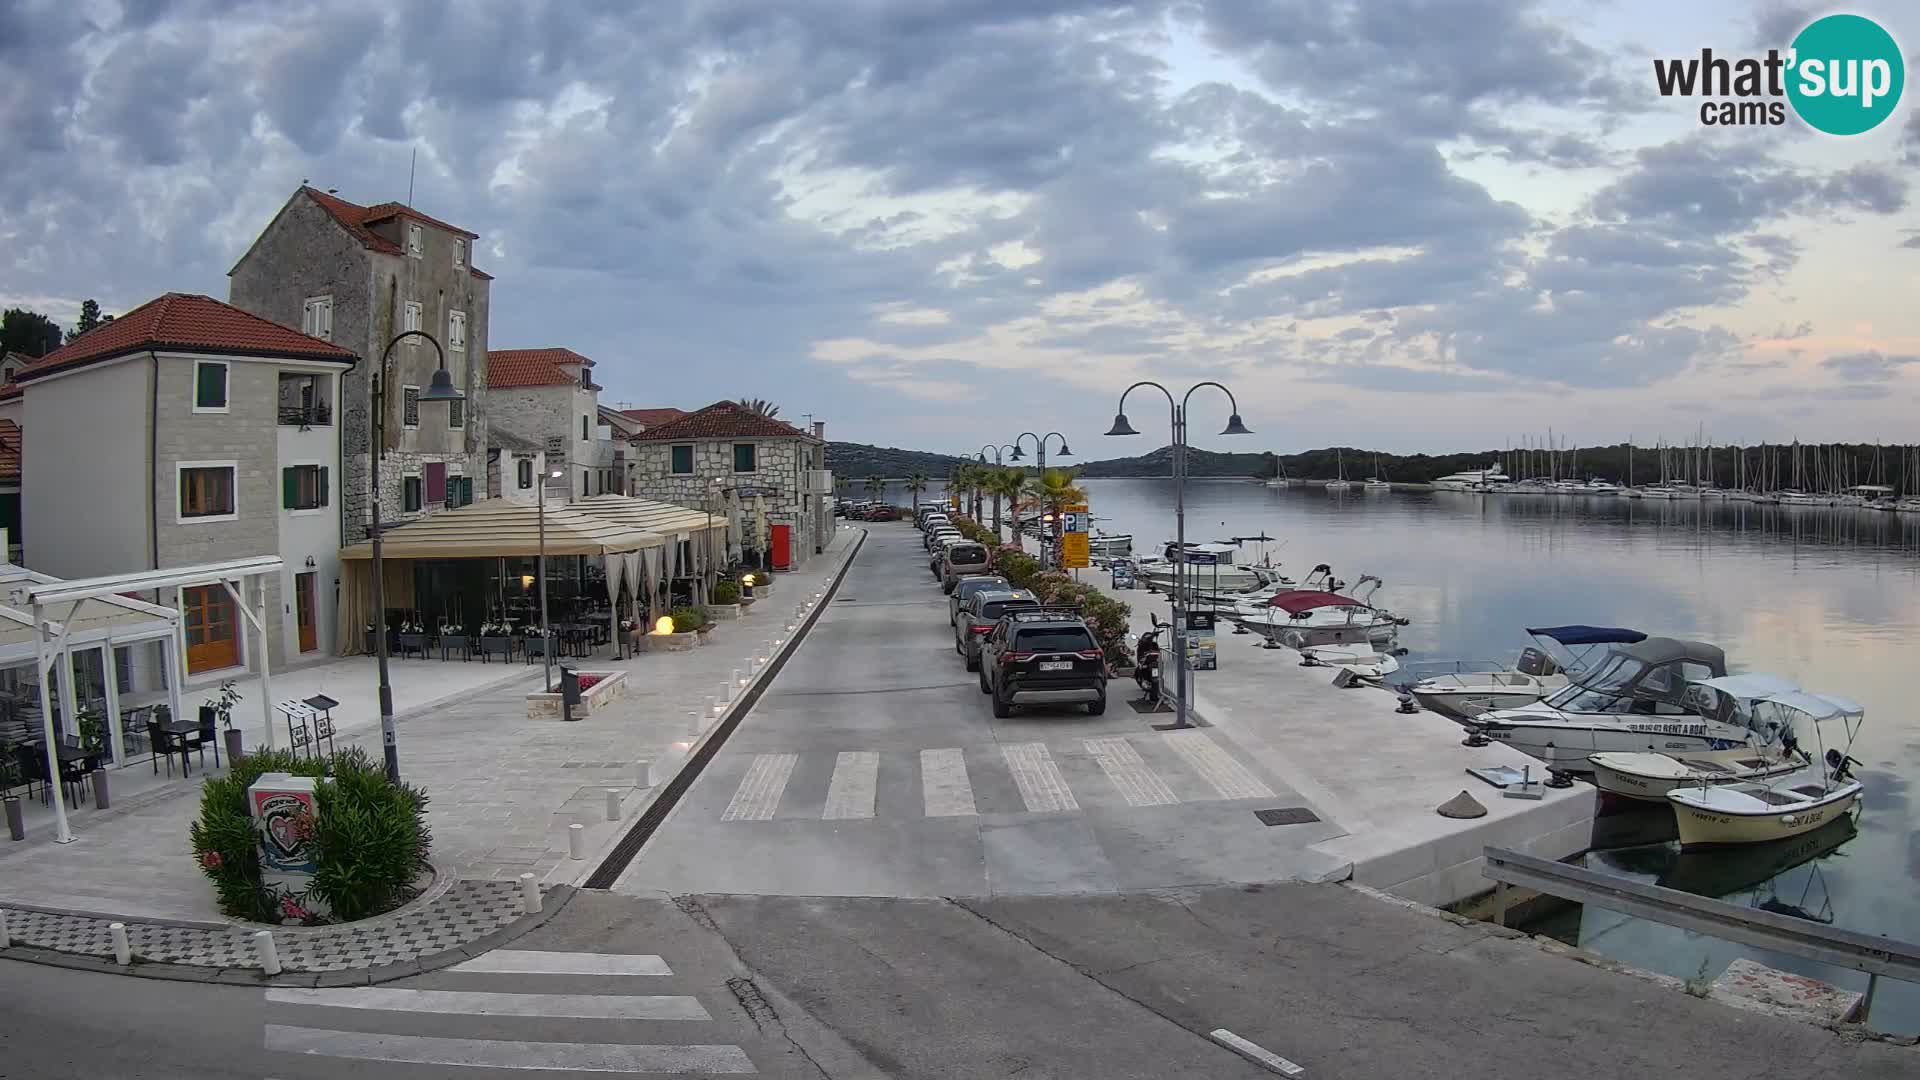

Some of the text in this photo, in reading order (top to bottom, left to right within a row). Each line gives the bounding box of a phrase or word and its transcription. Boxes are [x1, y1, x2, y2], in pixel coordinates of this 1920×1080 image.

[1065, 514, 1076, 531] P
[1662, 724, 1682, 734] RENT
[1683, 724, 1689, 735] A
[1689, 724, 1708, 736] BOAT
